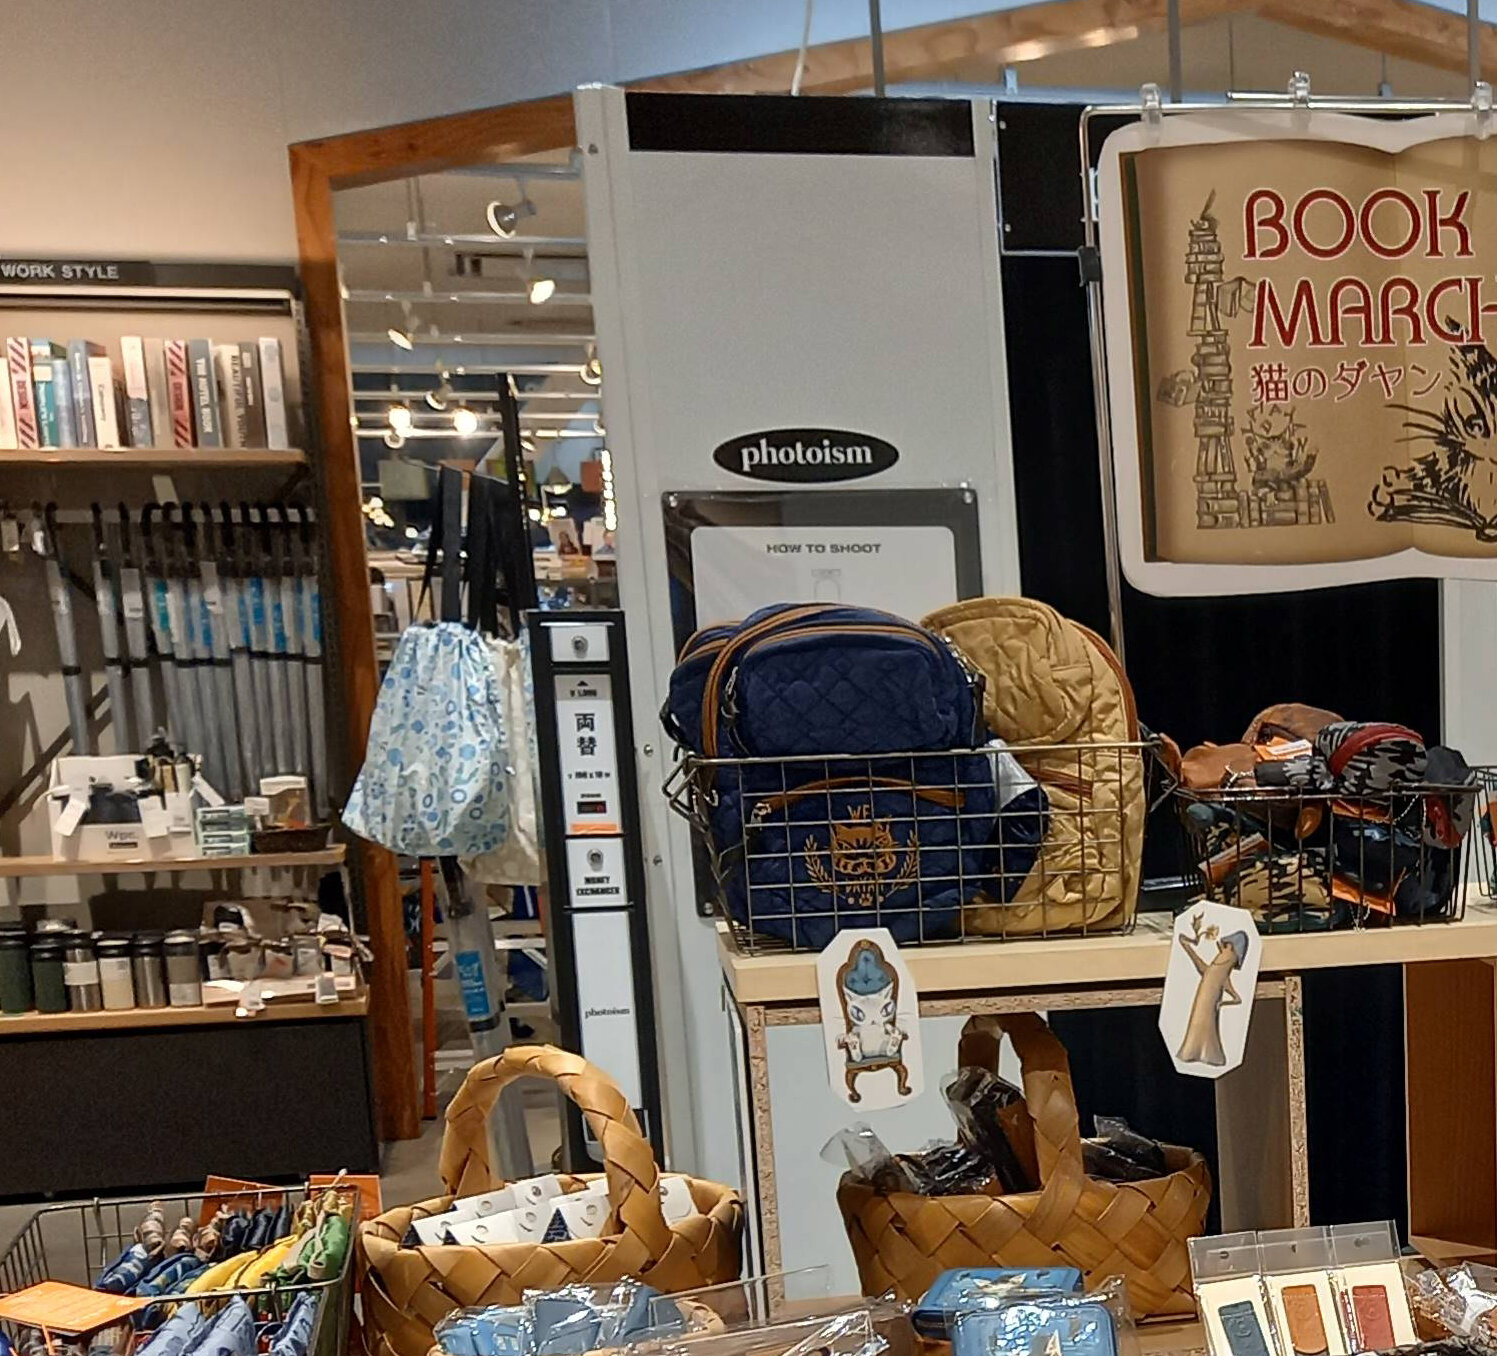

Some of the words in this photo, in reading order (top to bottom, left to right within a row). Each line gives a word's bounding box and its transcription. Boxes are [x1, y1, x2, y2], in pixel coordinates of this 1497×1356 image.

[1243, 187, 1474, 260] BOOK
[1, 264, 55, 280] WORK
[61, 264, 118, 280] STYLE
[1250, 361, 1447, 404] 猫のダヤン
[741, 439, 872, 471] photoism
[767, 543, 802, 554] HOW
[806, 543, 826, 554] TO
[829, 543, 882, 554] SHOOT
[575, 713, 597, 756] 両替
